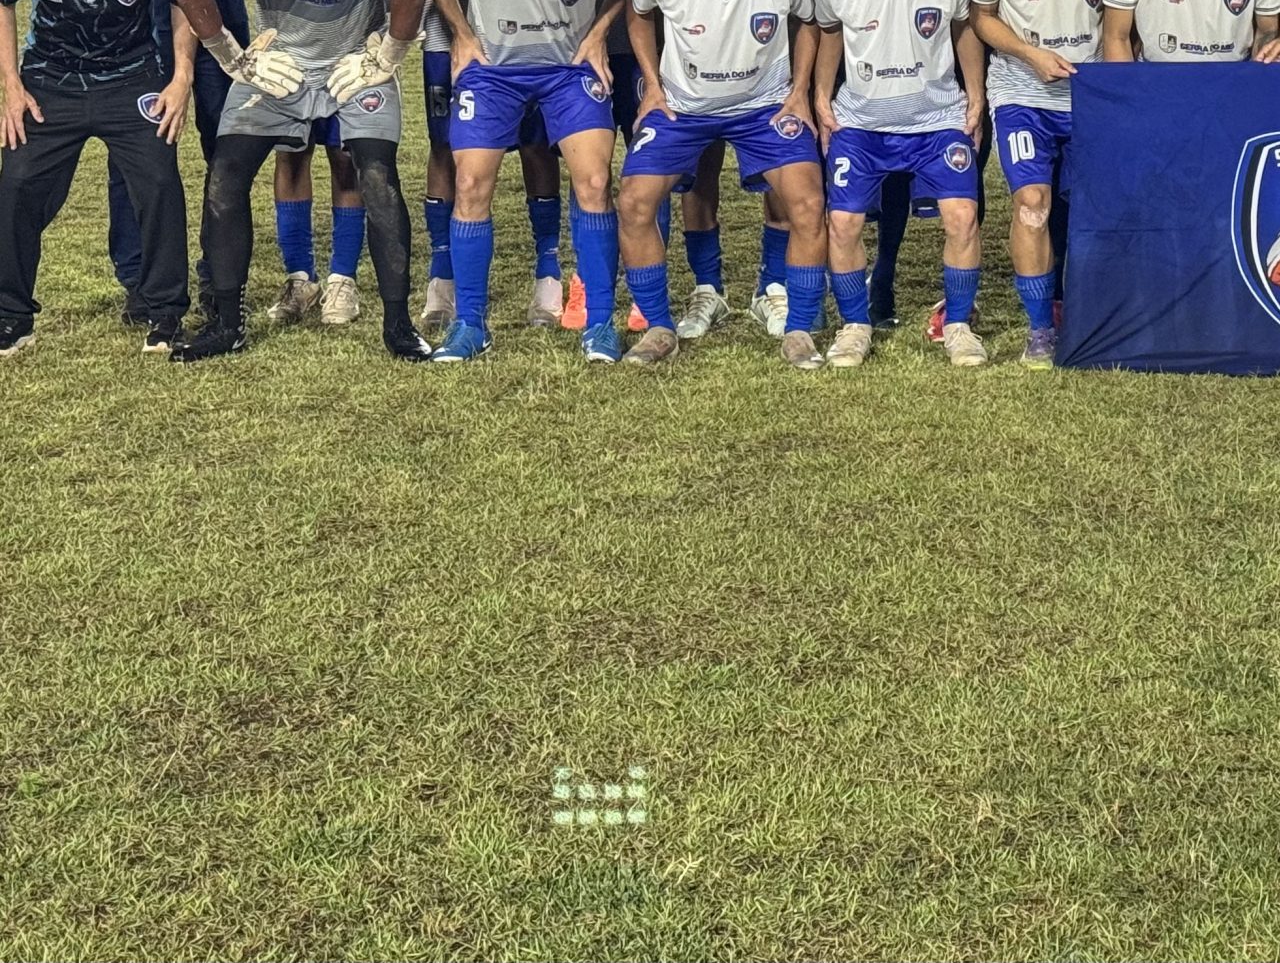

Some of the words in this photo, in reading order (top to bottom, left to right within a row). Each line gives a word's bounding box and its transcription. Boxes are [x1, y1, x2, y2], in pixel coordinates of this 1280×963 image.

[1180, 43, 1208, 52] SERRA
[876, 68, 905, 77] SERRA
[458, 90, 475, 120] 5
[1007, 130, 1035, 165] 10
[834, 157, 850, 188] 2
